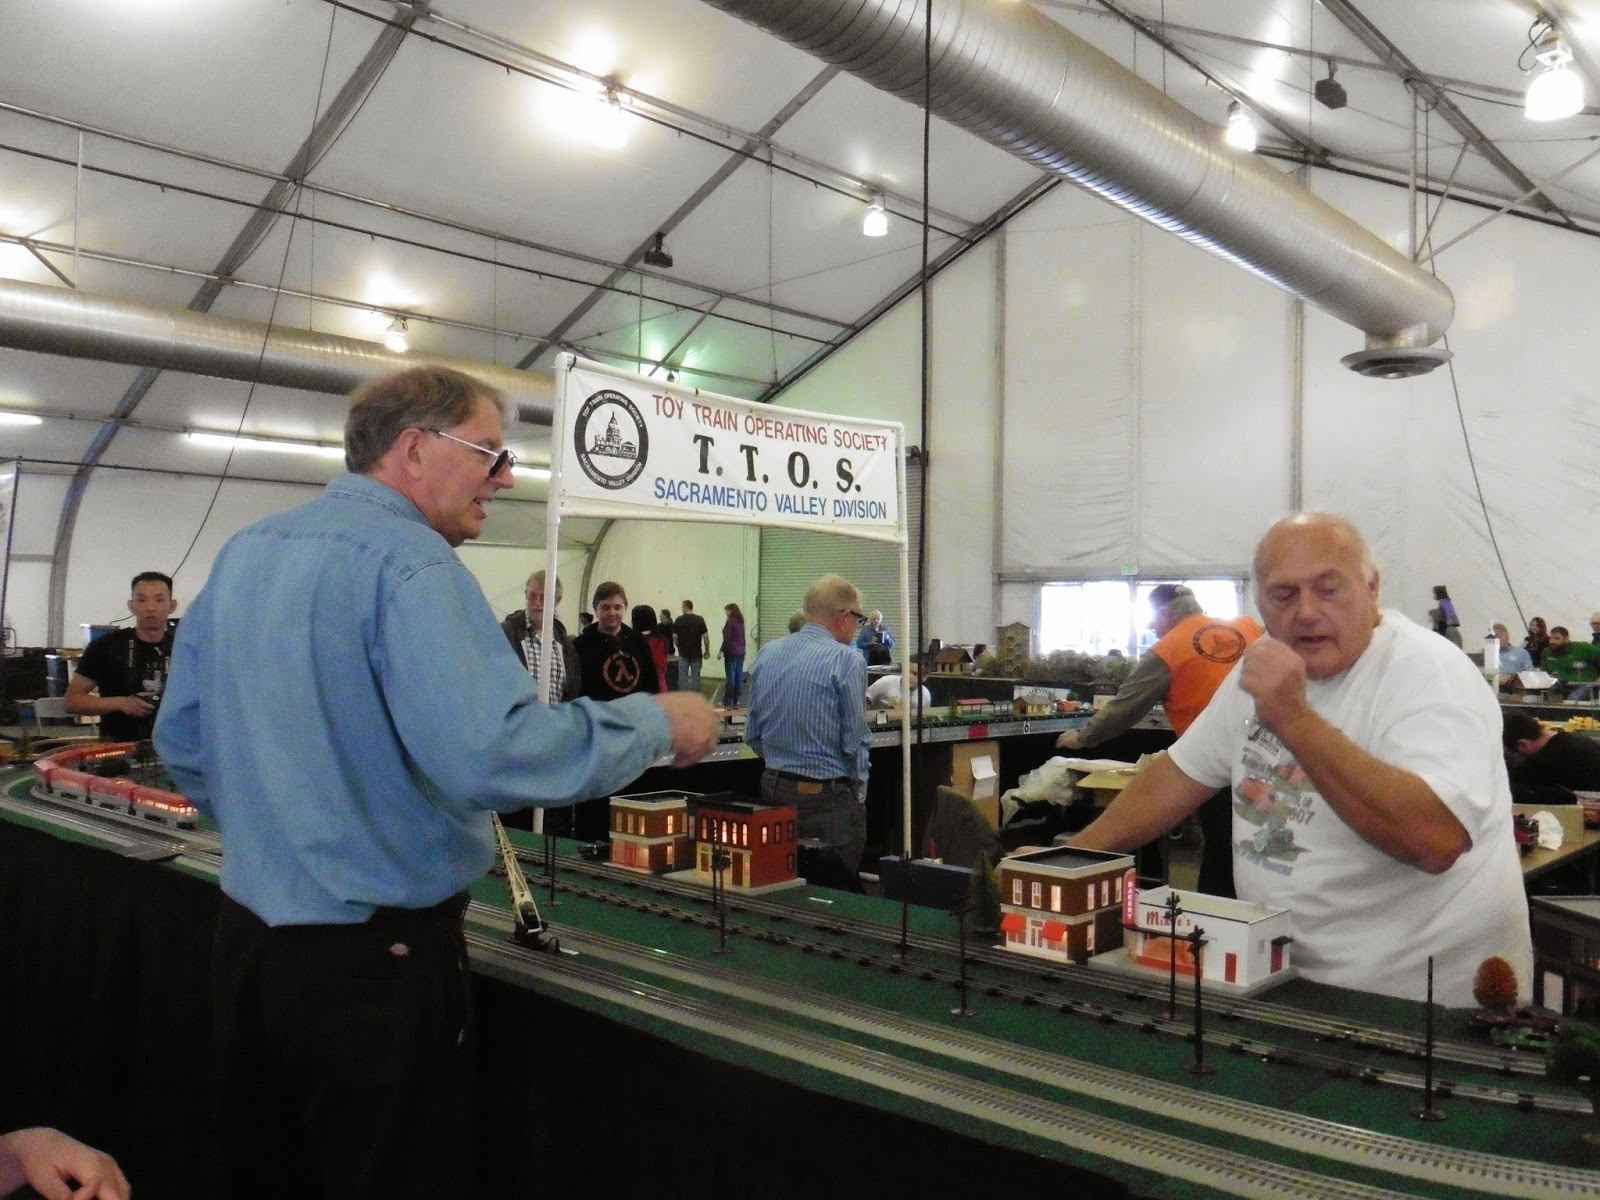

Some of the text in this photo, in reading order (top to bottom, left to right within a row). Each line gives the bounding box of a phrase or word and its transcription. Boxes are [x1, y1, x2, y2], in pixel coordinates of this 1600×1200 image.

[582, 392, 644, 428] TOY TRAIN OPERATING SOCIETY
[652, 394, 888, 452] TOY TRAIN OPERATING SOCIETY
[580, 453, 643, 486] SACRAMENTO VALLEY DIVISION
[693, 433, 861, 493] T. T. O. S.
[654, 476, 887, 520] SACRAMENTO VALLEY DIVISION
